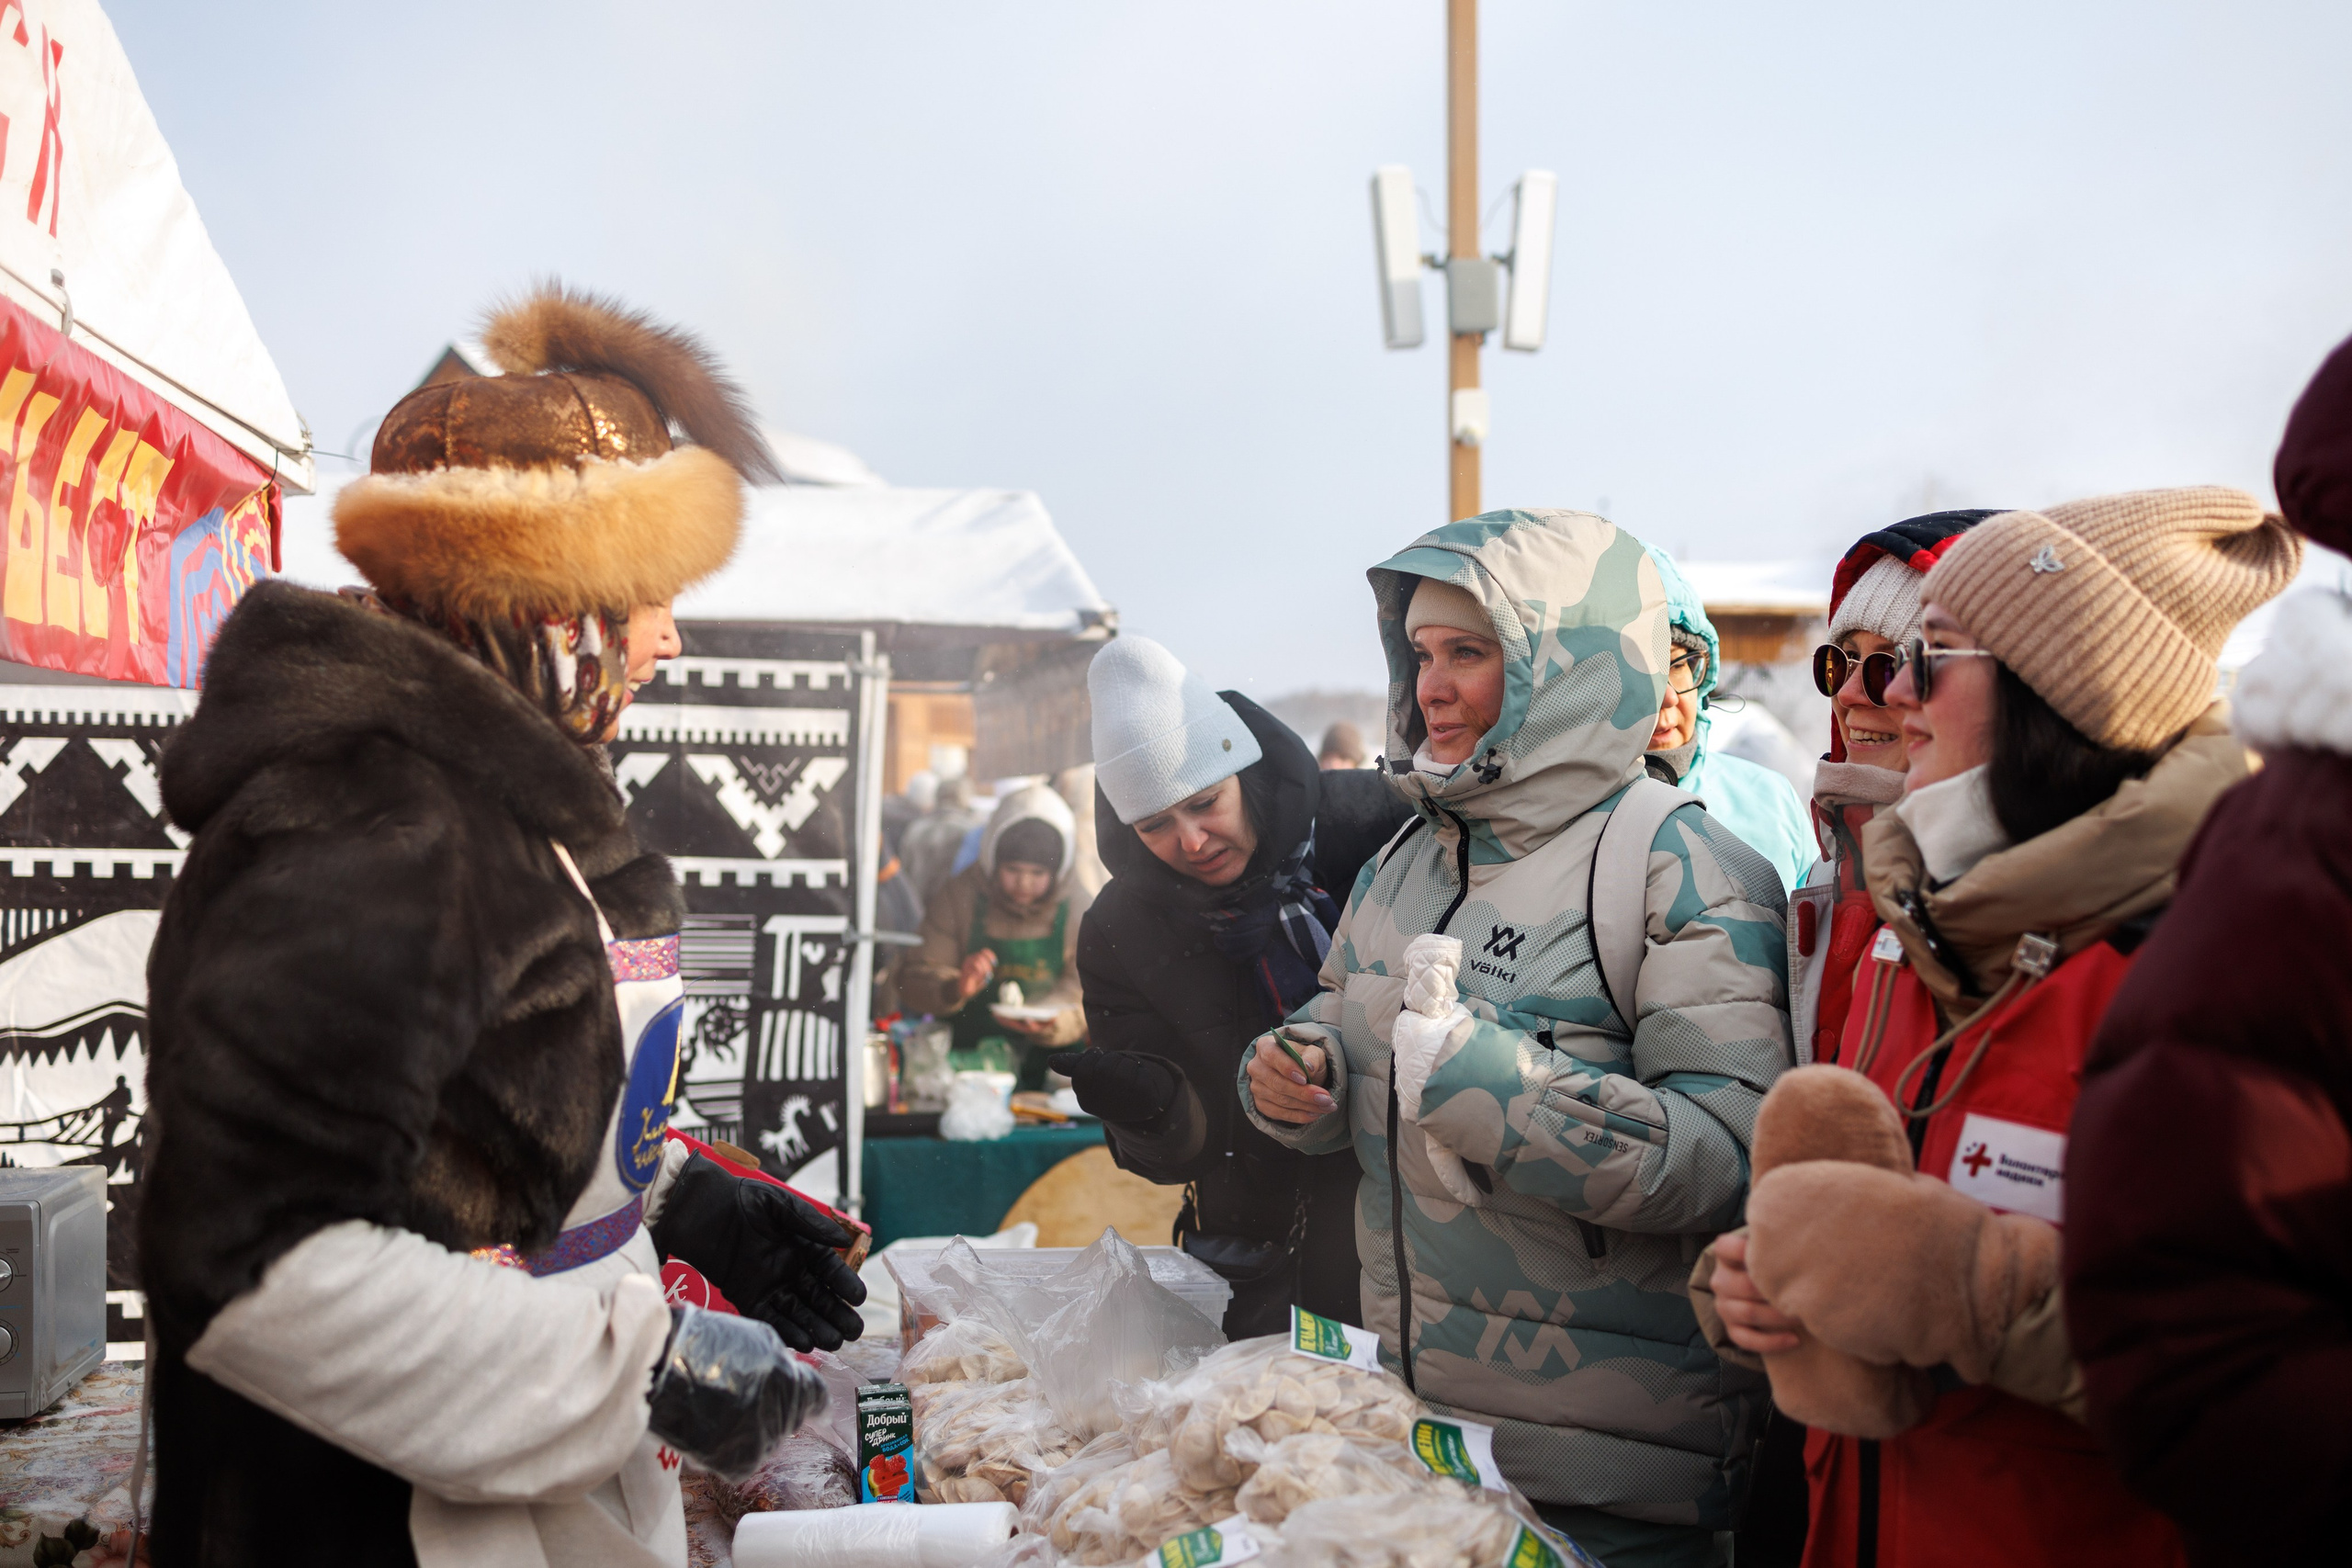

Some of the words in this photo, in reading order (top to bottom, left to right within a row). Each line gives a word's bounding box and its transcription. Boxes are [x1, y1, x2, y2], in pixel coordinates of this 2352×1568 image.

[1583, 1130, 1629, 1154] SENSORTEX
[866, 1412, 907, 1428] Добрый
[865, 1427, 888, 1444] СУПЕР
[871, 1432, 897, 1448] ДРИНК
